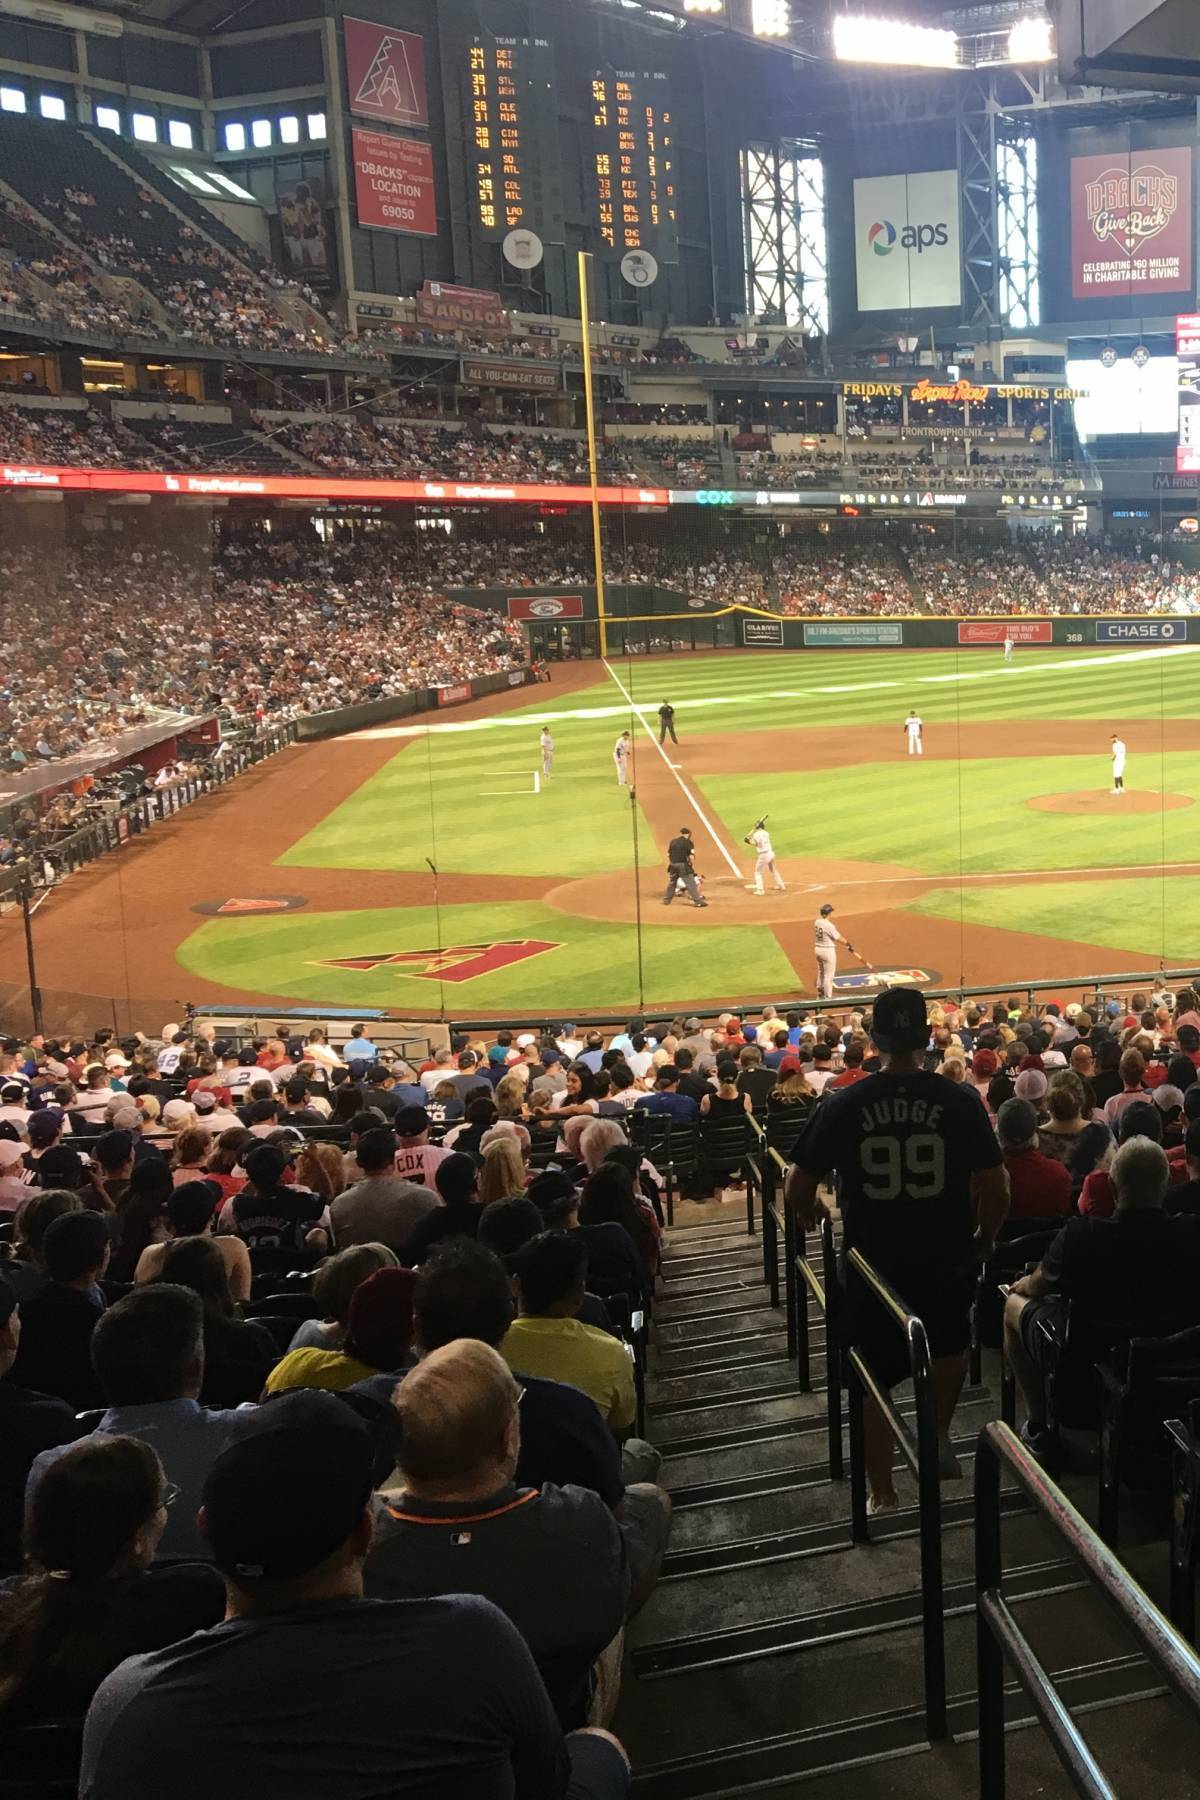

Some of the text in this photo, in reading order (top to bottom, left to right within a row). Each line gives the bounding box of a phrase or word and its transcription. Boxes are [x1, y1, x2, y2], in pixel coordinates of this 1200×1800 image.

[495, 37, 516, 45] TEAM
[470, 48, 483, 58] 44
[471, 59, 512, 69] 27 PHI
[472, 74, 514, 85] 39 STL
[473, 86, 486, 95] 31
[474, 101, 516, 111] 28 CLE
[475, 112, 516, 121] 31 MIA
[595, 116, 606, 125] 57
[476, 127, 517, 137] 28 CIN
[476, 138, 489, 147] 48
[504, 165, 519, 173] ATL
[371, 179, 421, 198] LOCATION
[480, 190, 521, 200] 57 MIL
[623, 190, 637, 198] TEX
[382, 205, 414, 220] 69050
[601, 214, 612, 222] 55
[1095, 207, 1165, 238] Give Back
[901, 223, 948, 253] aps
[1083, 260, 1130, 272] CELEBRATING
[1149, 257, 1179, 267] MILLION
[1083, 267, 1179, 283] IN CHARITABLE GIVING
[422, 302, 505, 324] SANDLOT
[534, 375, 555, 385] SEATS
[843, 384, 902, 396] FRIDAYS
[911, 379, 955, 401] Front
[953, 380, 988, 400] Row
[997, 387, 1049, 399] SPORTS
[901, 426, 996, 437] FRONTROWPHOENIX.com
[696, 490, 733, 504] COX
[1109, 625, 1158, 637] CHASE
[1066, 634, 1082, 642] 368
[239, 1072, 250, 1082] 2
[861, 1098, 944, 1132] JUDGE
[397, 1154, 424, 1172] COX
[861, 1134, 945, 1200] 99
